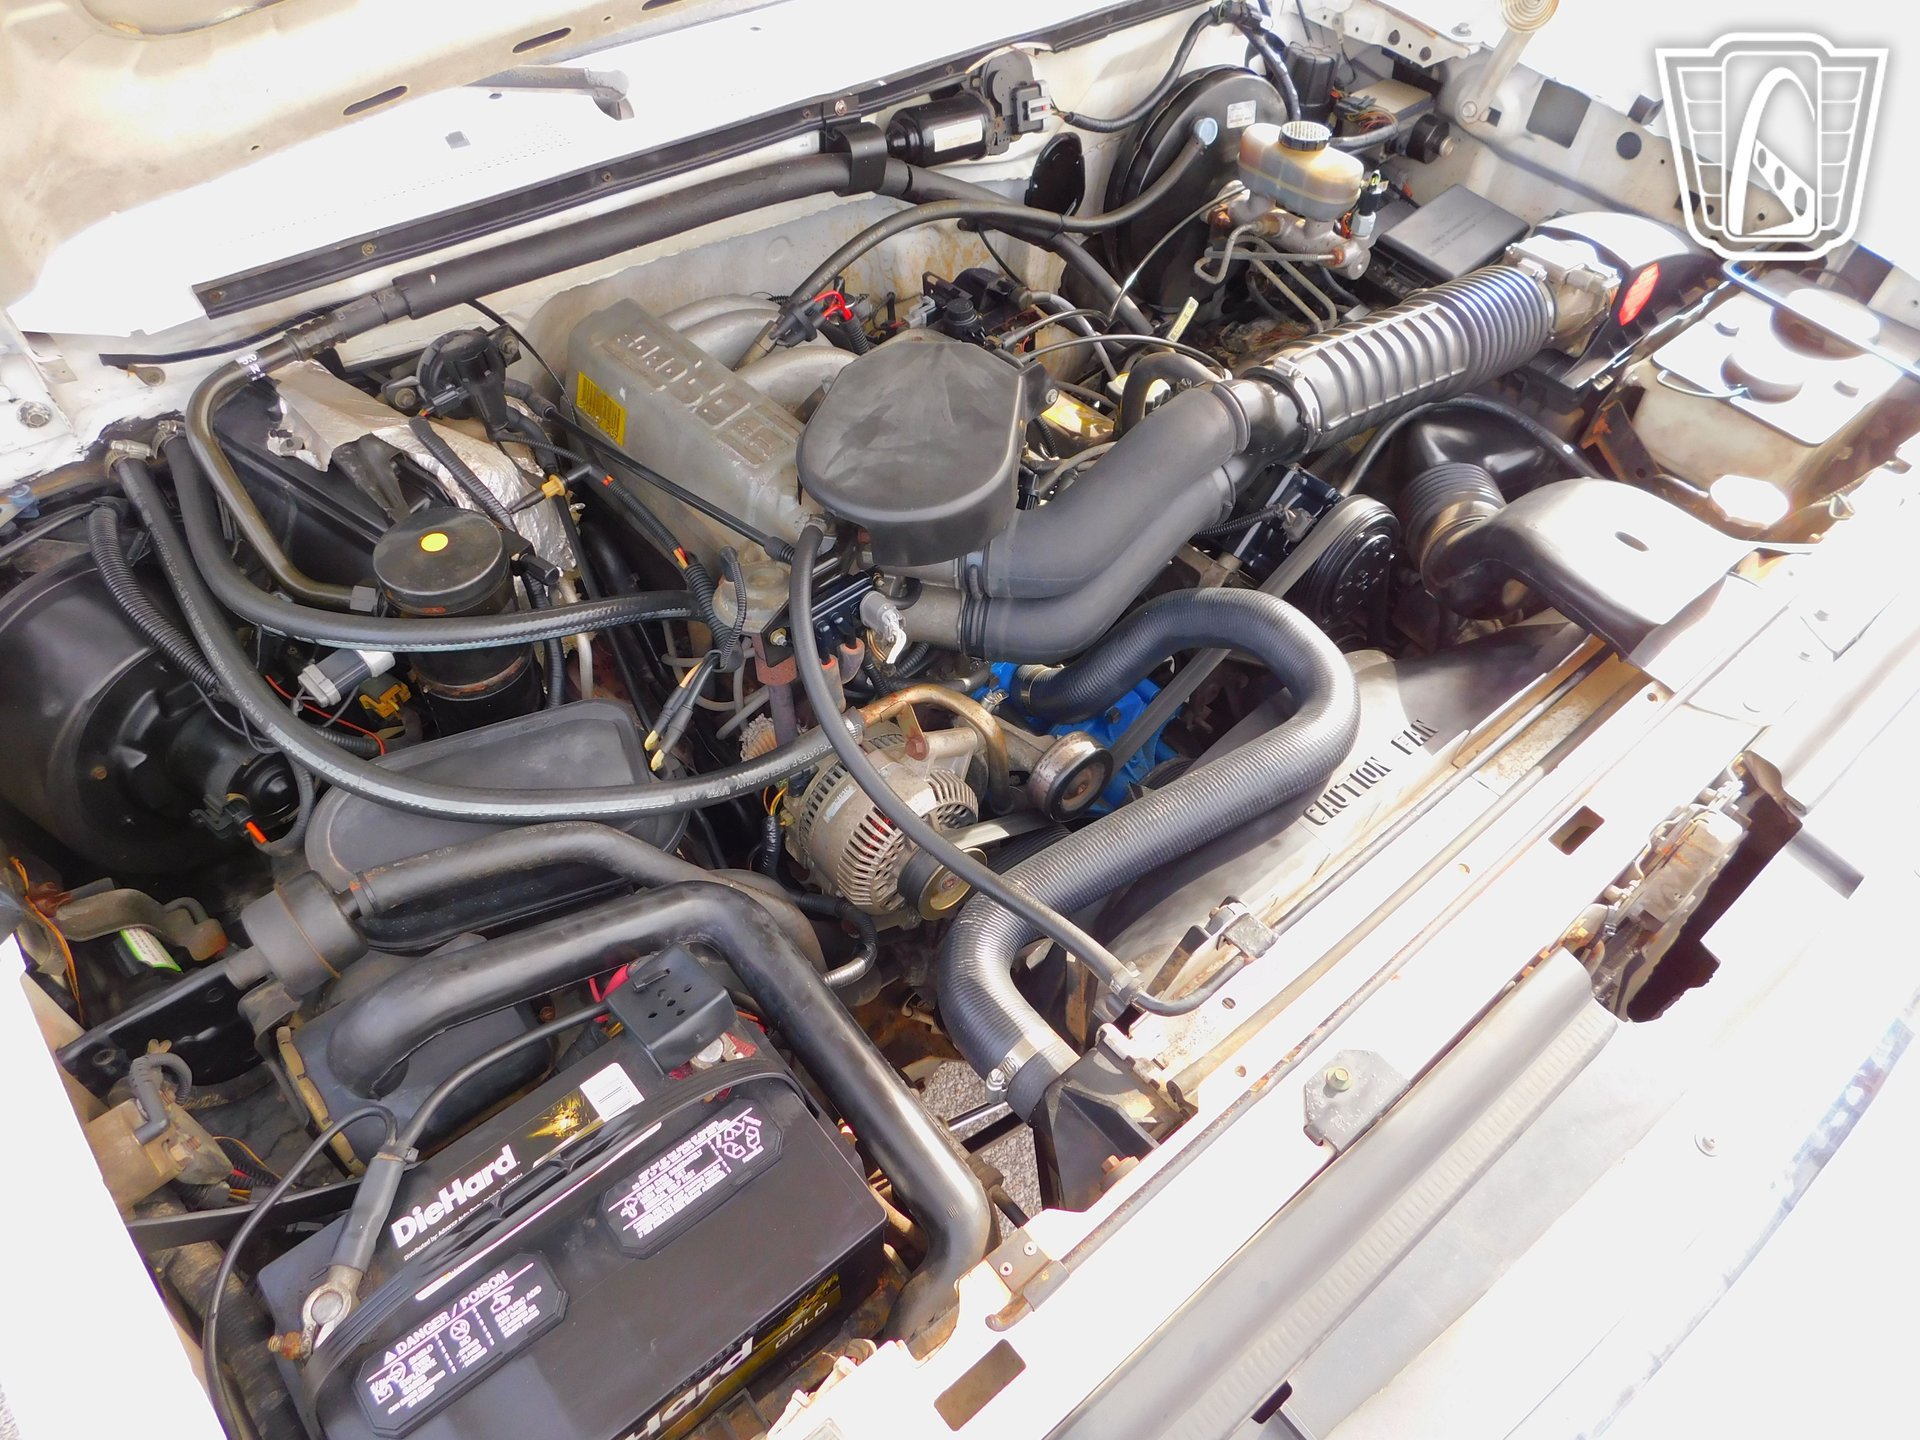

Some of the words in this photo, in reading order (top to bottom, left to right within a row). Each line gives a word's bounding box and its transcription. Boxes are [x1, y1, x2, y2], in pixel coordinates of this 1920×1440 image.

[795, 746, 820, 764] GATES
[1303, 756, 1392, 826] CAUTION
[1391, 719, 1440, 755] FAN
[391, 1144, 518, 1248] DieHard
[395, 1311, 450, 1353] DANGER
[460, 1270, 509, 1309] POISON
[776, 1302, 827, 1349] GOLD
